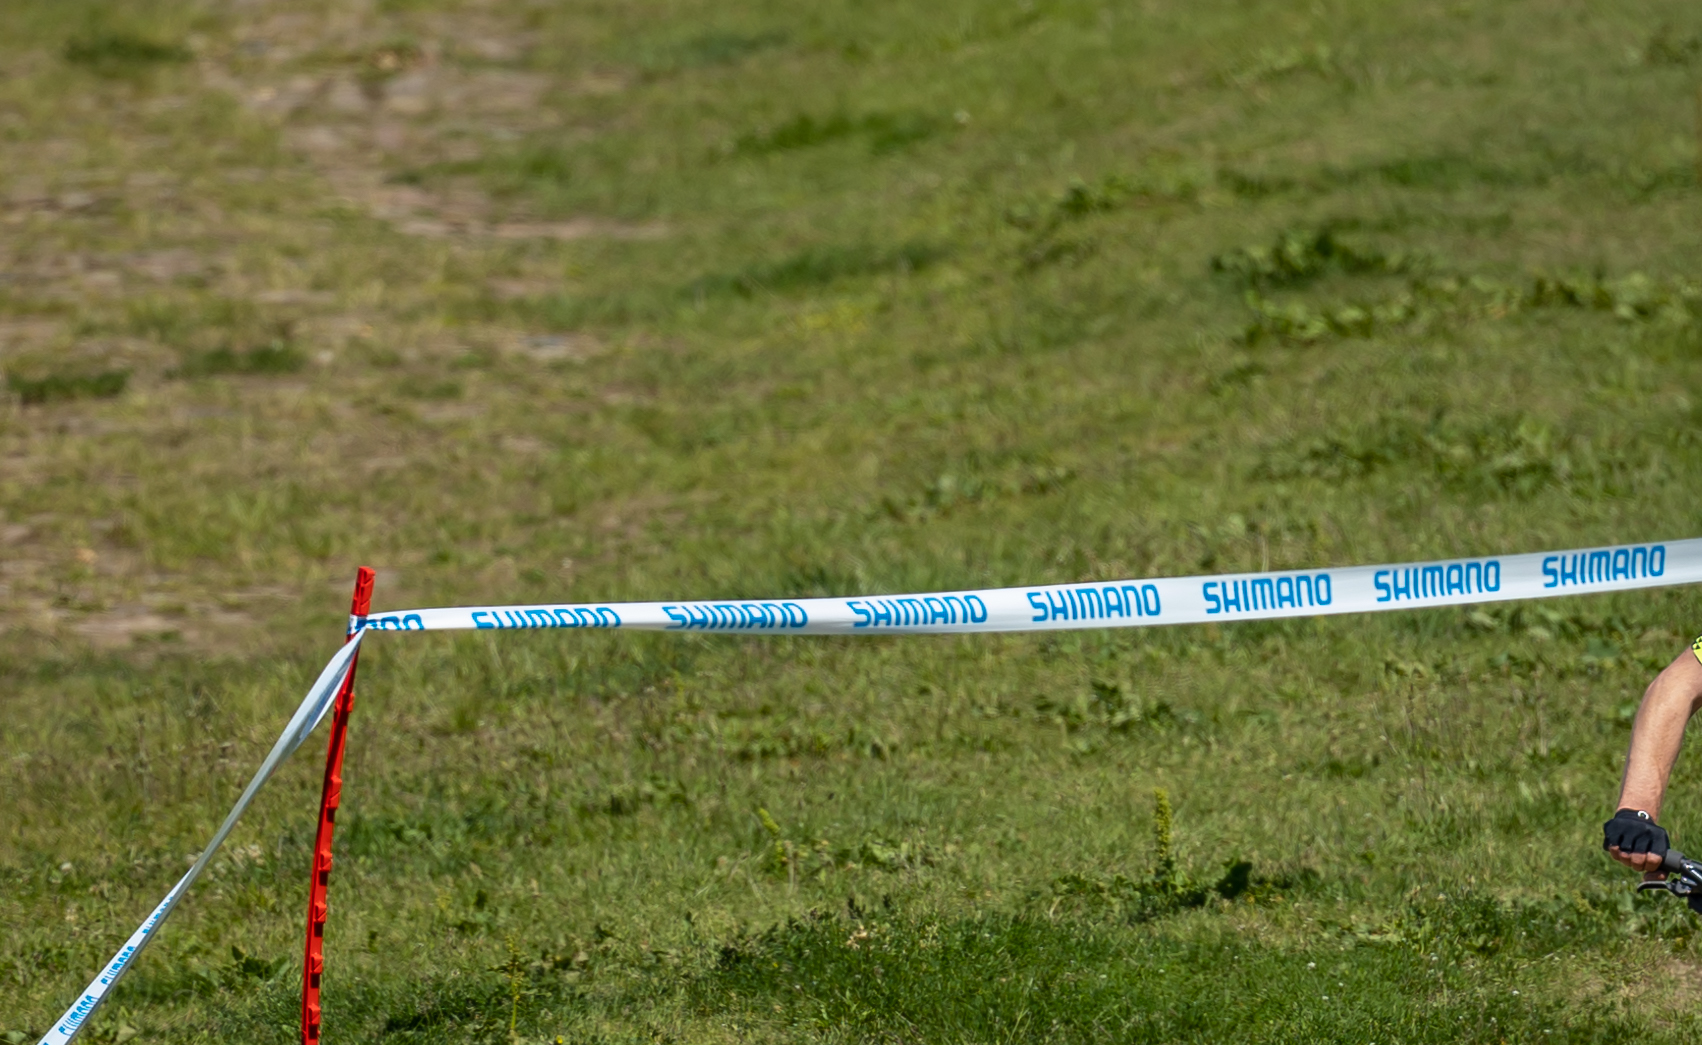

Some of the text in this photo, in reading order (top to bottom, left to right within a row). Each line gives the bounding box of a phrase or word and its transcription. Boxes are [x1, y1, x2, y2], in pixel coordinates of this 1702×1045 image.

[1373, 560, 1500, 602] SHIMANO
[1542, 545, 1666, 588] SHIMANO
[846, 595, 988, 628] SHIMANO
[1026, 584, 1161, 622] SHIMANO
[1202, 573, 1332, 614] SHIMANO
[662, 603, 808, 629] SHIMANO
